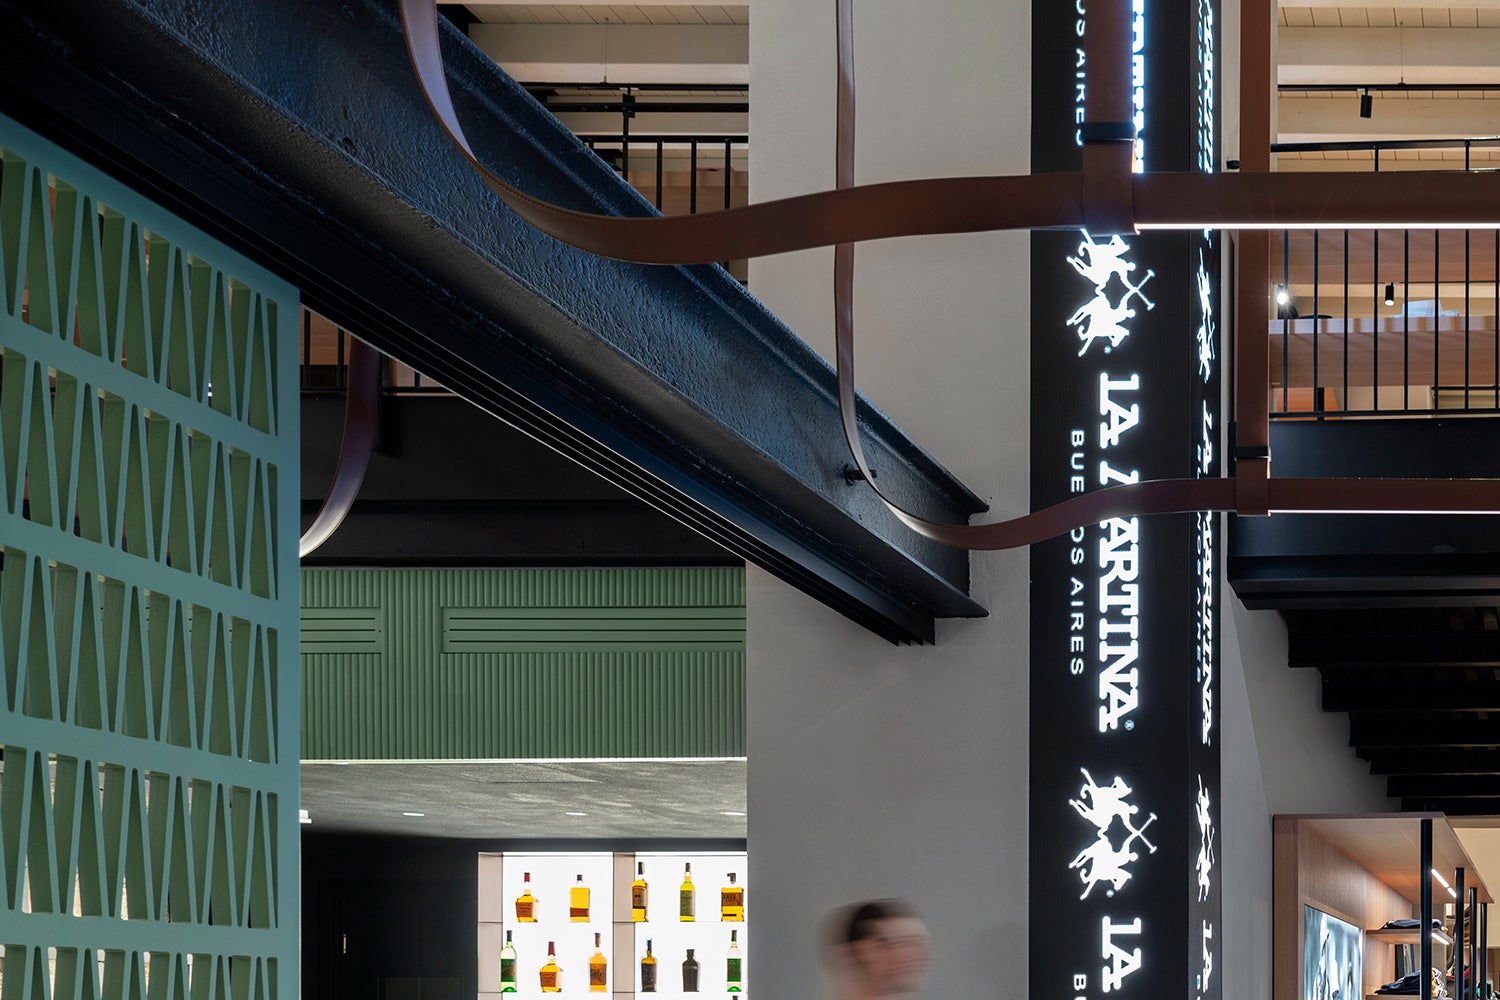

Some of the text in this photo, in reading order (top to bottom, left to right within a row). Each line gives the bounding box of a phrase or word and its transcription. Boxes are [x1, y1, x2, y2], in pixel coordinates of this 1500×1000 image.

[1100, 372, 1140, 449] LA
[1070, 430, 1085, 675] BUEOS AIRES
[1102, 916, 1142, 993] LA
